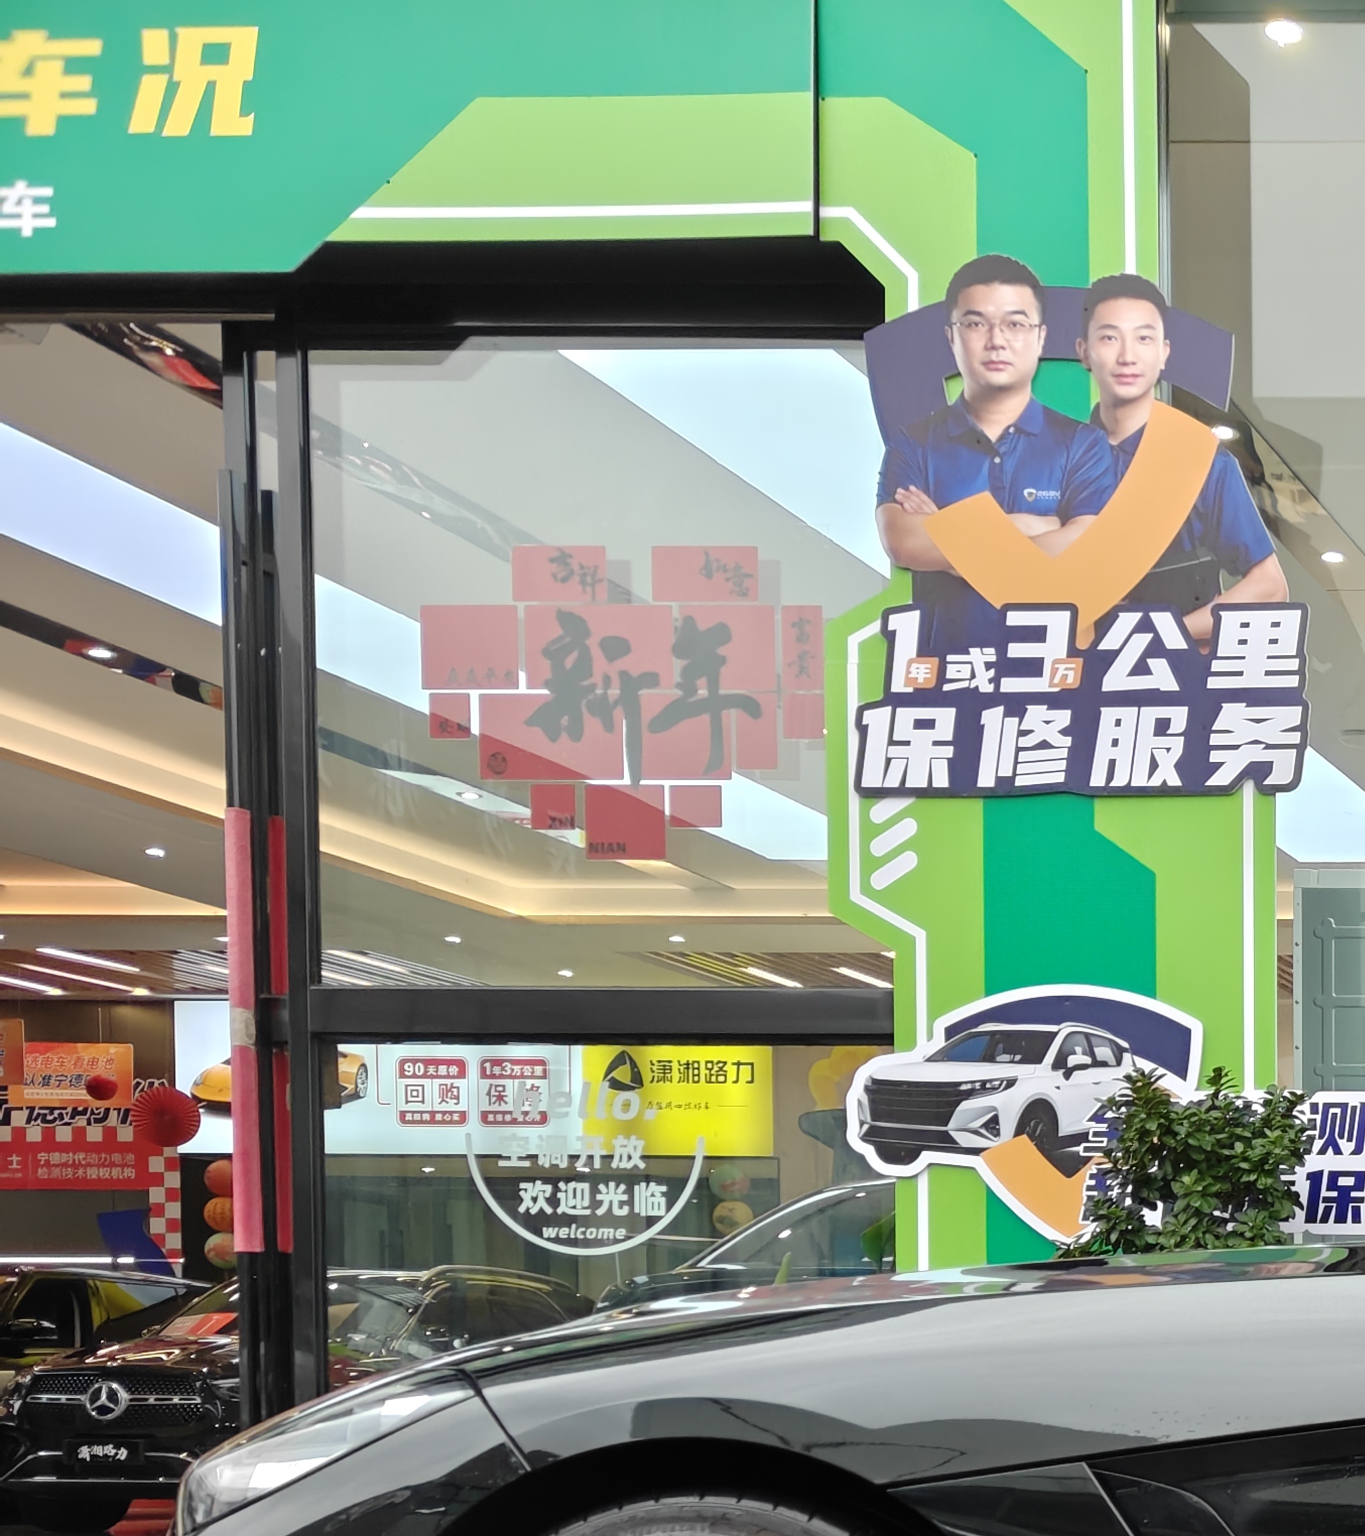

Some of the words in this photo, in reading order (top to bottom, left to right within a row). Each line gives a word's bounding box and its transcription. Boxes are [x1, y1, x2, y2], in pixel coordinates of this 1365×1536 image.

[0, 26, 258, 136] 车况
[548, 549, 609, 601] 吉祥
[524, 608, 762, 790] 新年
[861, 703, 1302, 789] 保修服务
[25, 1054, 115, 1070] 选电车看电池
[649, 1059, 755, 1085] 潇湘路力
[24, 1073, 116, 1088] 认准宁德
[404, 1083, 461, 1106] 回购
[37, 1151, 135, 1165] 宁德时代动力电池
[497, 1133, 647, 1170] 空调开放
[37, 1167, 136, 1180] 检测技术授权机构
[517, 1179, 668, 1217] 欢迎光临
[541, 1223, 627, 1240] welcome
